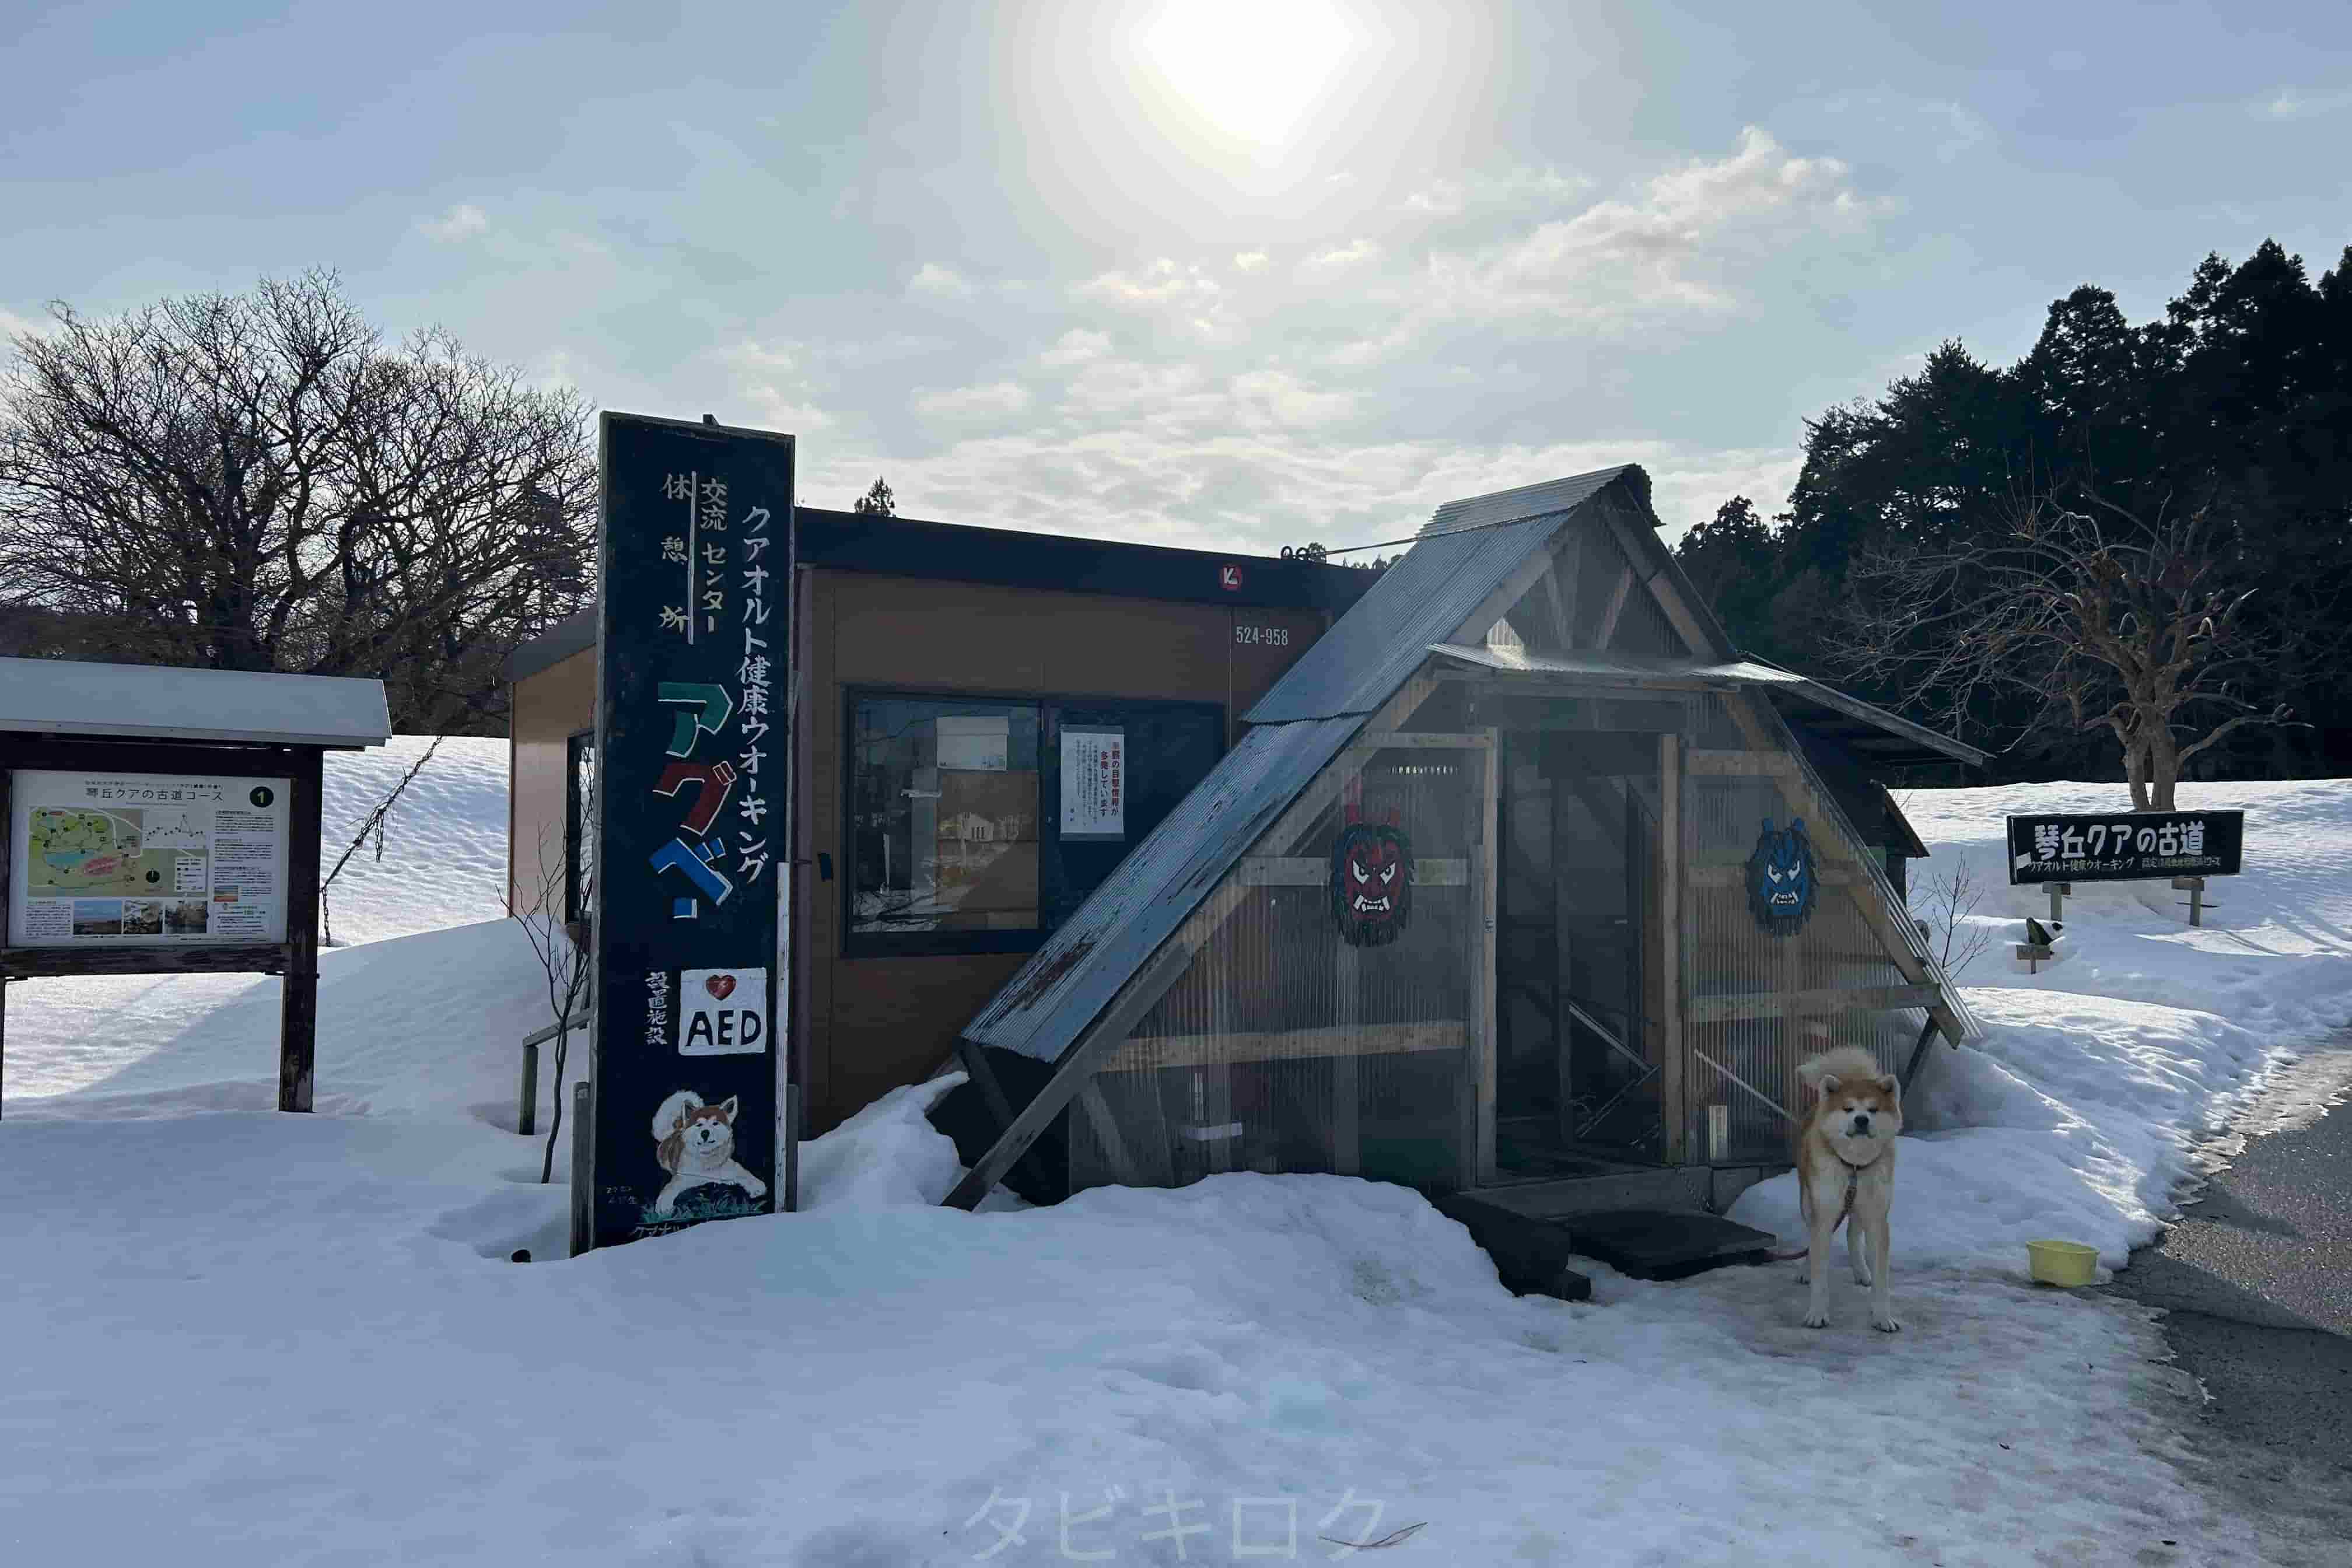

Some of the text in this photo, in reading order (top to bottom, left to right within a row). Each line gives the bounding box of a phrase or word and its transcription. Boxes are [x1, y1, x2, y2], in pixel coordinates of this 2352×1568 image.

[659, 473, 692, 634] 休憩所
[1236, 626, 1289, 645] 524-958
[257, 791, 265, 803] 1
[2034, 820, 2205, 860] 琴丘クアの古道
[644, 971, 671, 1046] 設置施設
[685, 1009, 762, 1046] AED
